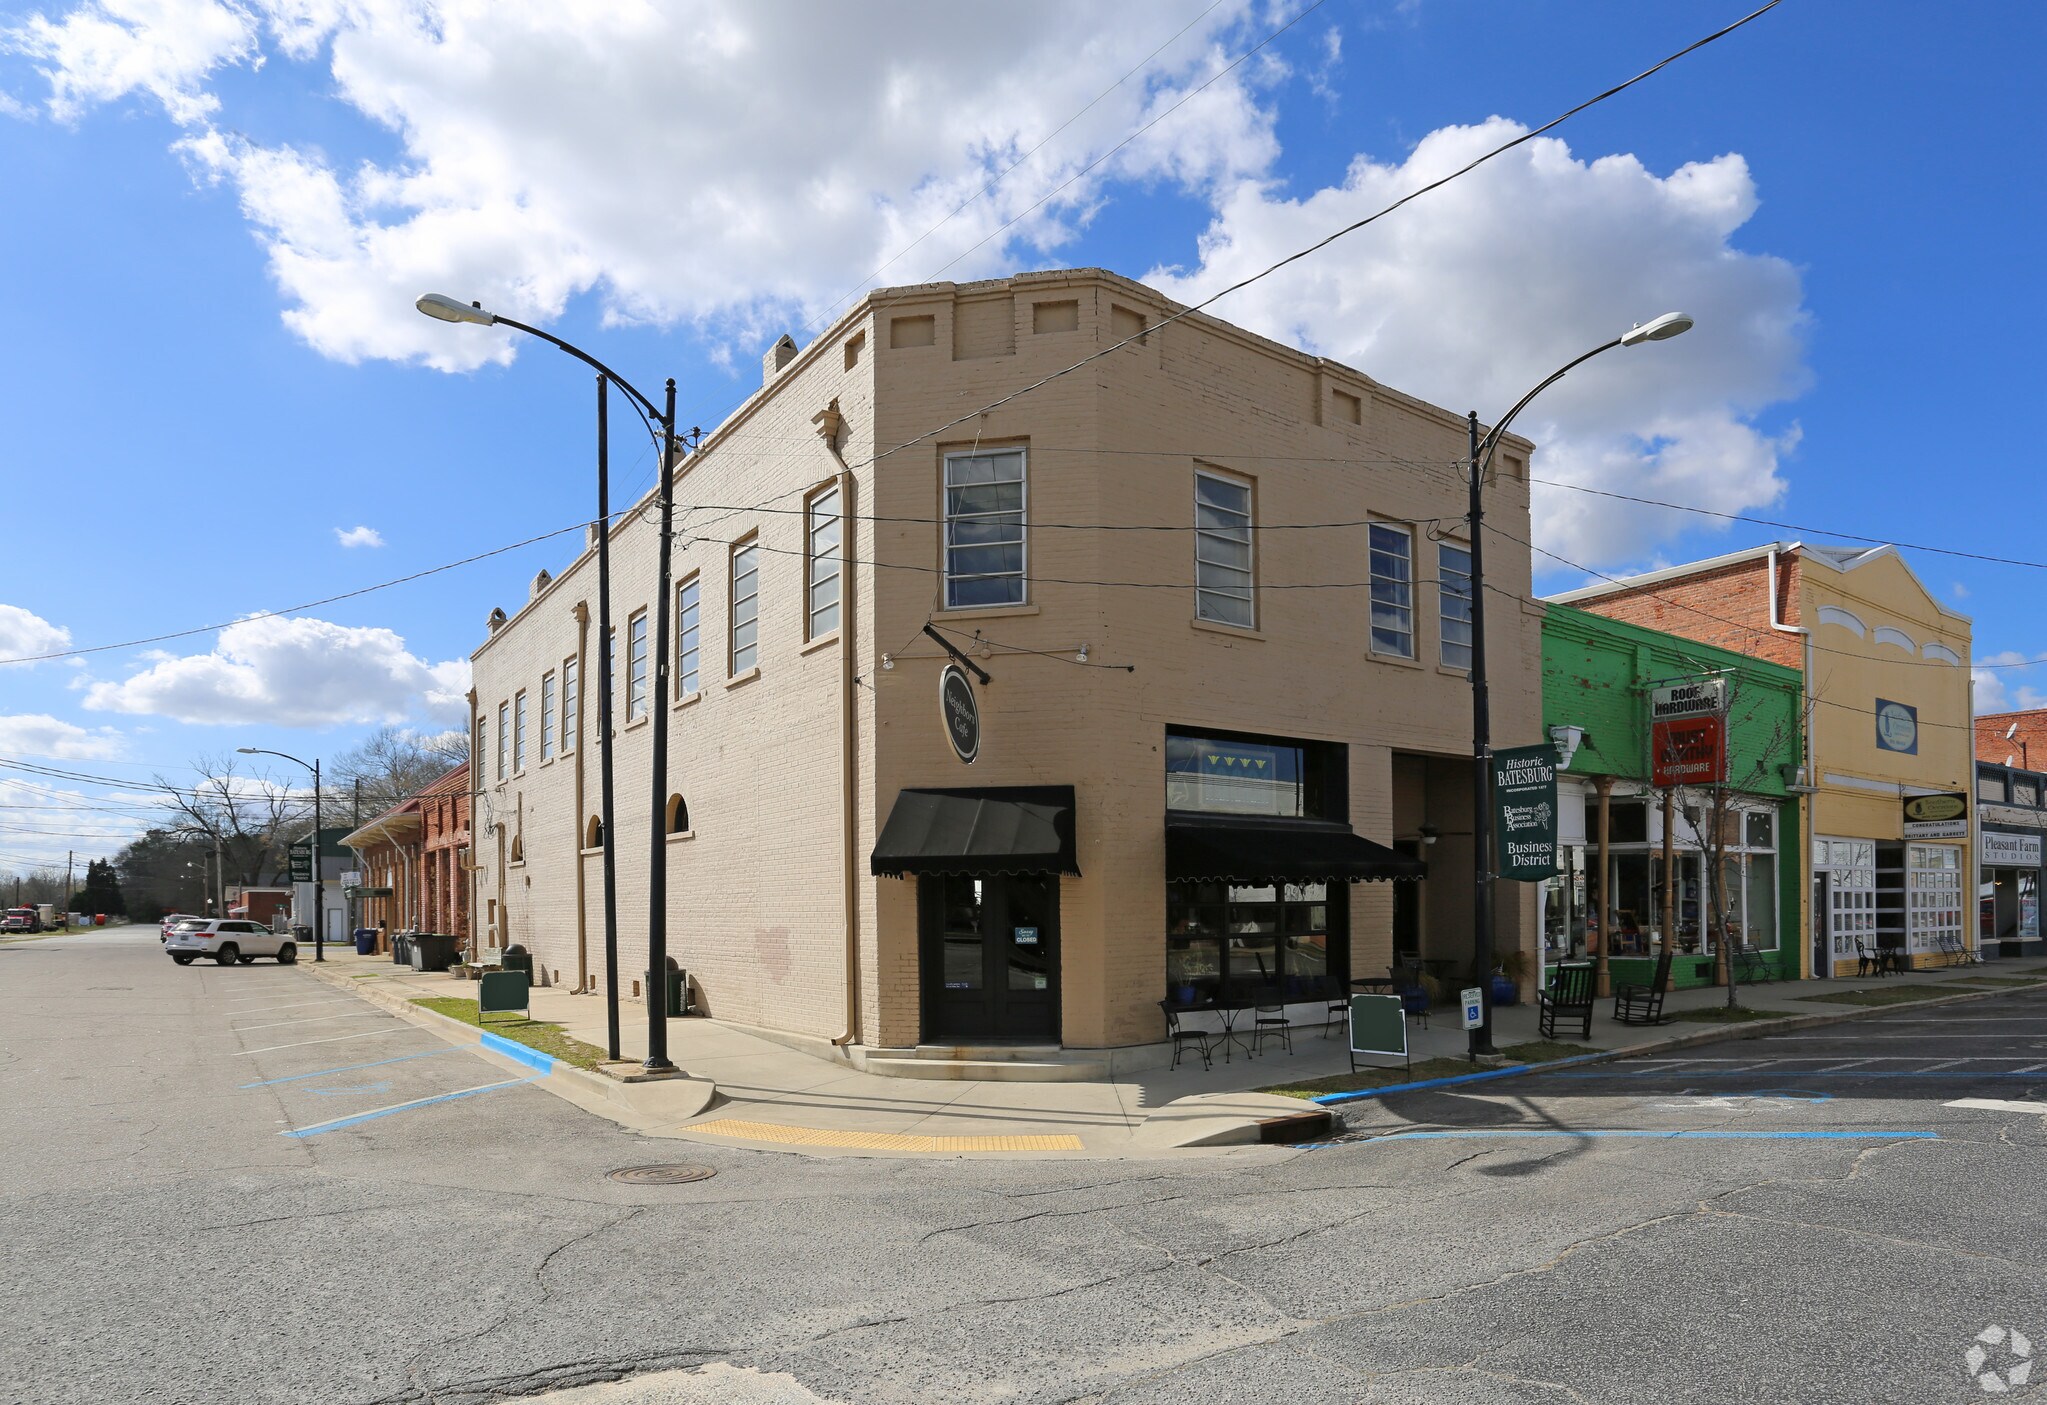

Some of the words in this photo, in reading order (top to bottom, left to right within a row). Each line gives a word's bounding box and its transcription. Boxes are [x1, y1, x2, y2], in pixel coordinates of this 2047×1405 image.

[1671, 685, 1700, 701] ROOF
[945, 688, 975, 725] Neighbors
[1654, 697, 1717, 716] HARDWARE
[954, 716, 969, 738] Cafe
[1506, 756, 1544, 770] Historic
[1663, 762, 1710, 775] HARDWARE
[1497, 765, 1553, 787] BATESBURG
[1503, 805, 1533, 818] Batesburg
[1506, 813, 1531, 825] Business
[1506, 821, 1538, 832] Association
[1507, 841, 1553, 855] Business
[1985, 835, 2017, 851] Pleasant
[2019, 838, 2039, 852] Farm
[1512, 853, 1551, 867] District
[1985, 852, 2039, 860] STUDIOS
